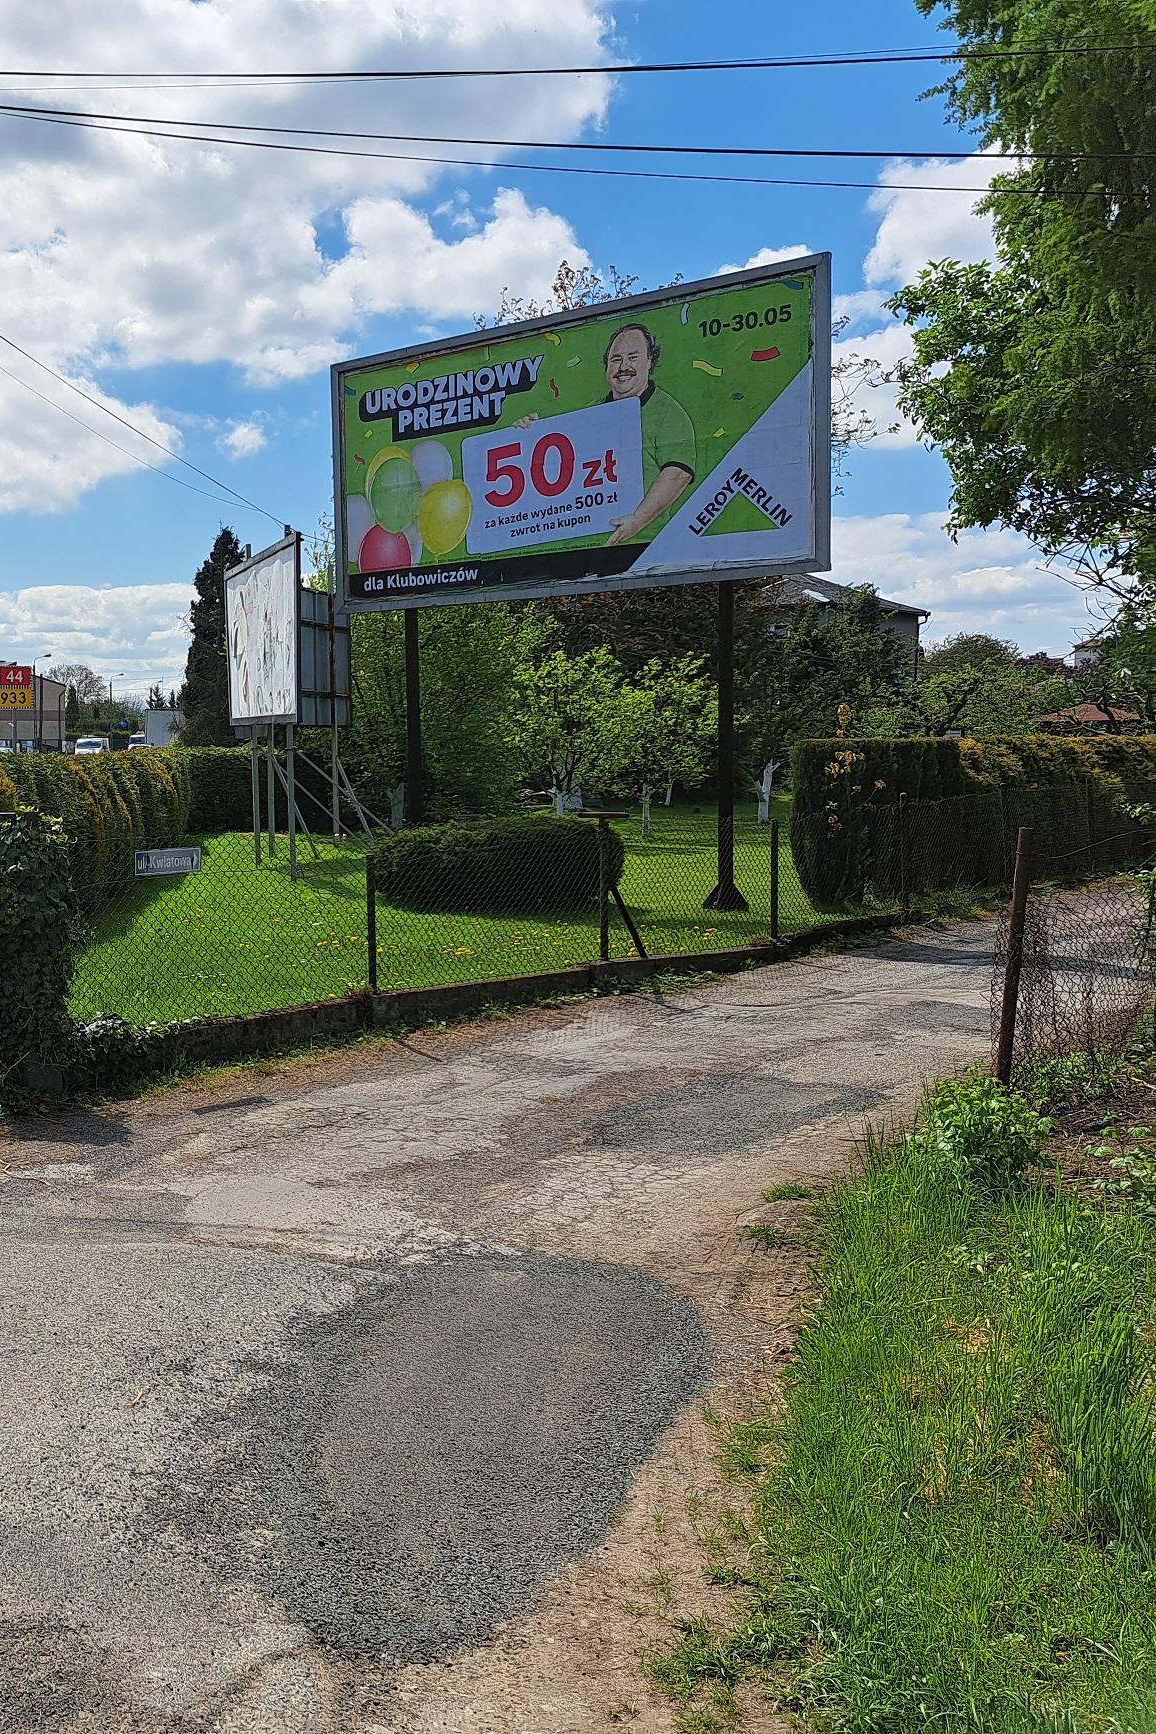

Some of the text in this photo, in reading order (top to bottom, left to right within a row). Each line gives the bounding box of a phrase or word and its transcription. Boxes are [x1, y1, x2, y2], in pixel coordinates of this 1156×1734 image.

[699, 303, 792, 338] 10-30.05
[365, 355, 543, 414] URODZINOWY
[398, 392, 507, 433] PREZENT
[484, 432, 618, 508] 50 zł
[484, 491, 618, 529] za każde wydane 500 zł
[688, 479, 735, 536] LEROY
[730, 467, 793, 527] MERLIN
[510, 514, 591, 538] zwrot na kupon
[363, 566, 479, 592] dla Klubowiczów
[6, 670, 23, 683] 44
[0, 691, 27, 705] 933
[149, 855, 192, 869] Kwiatowa
